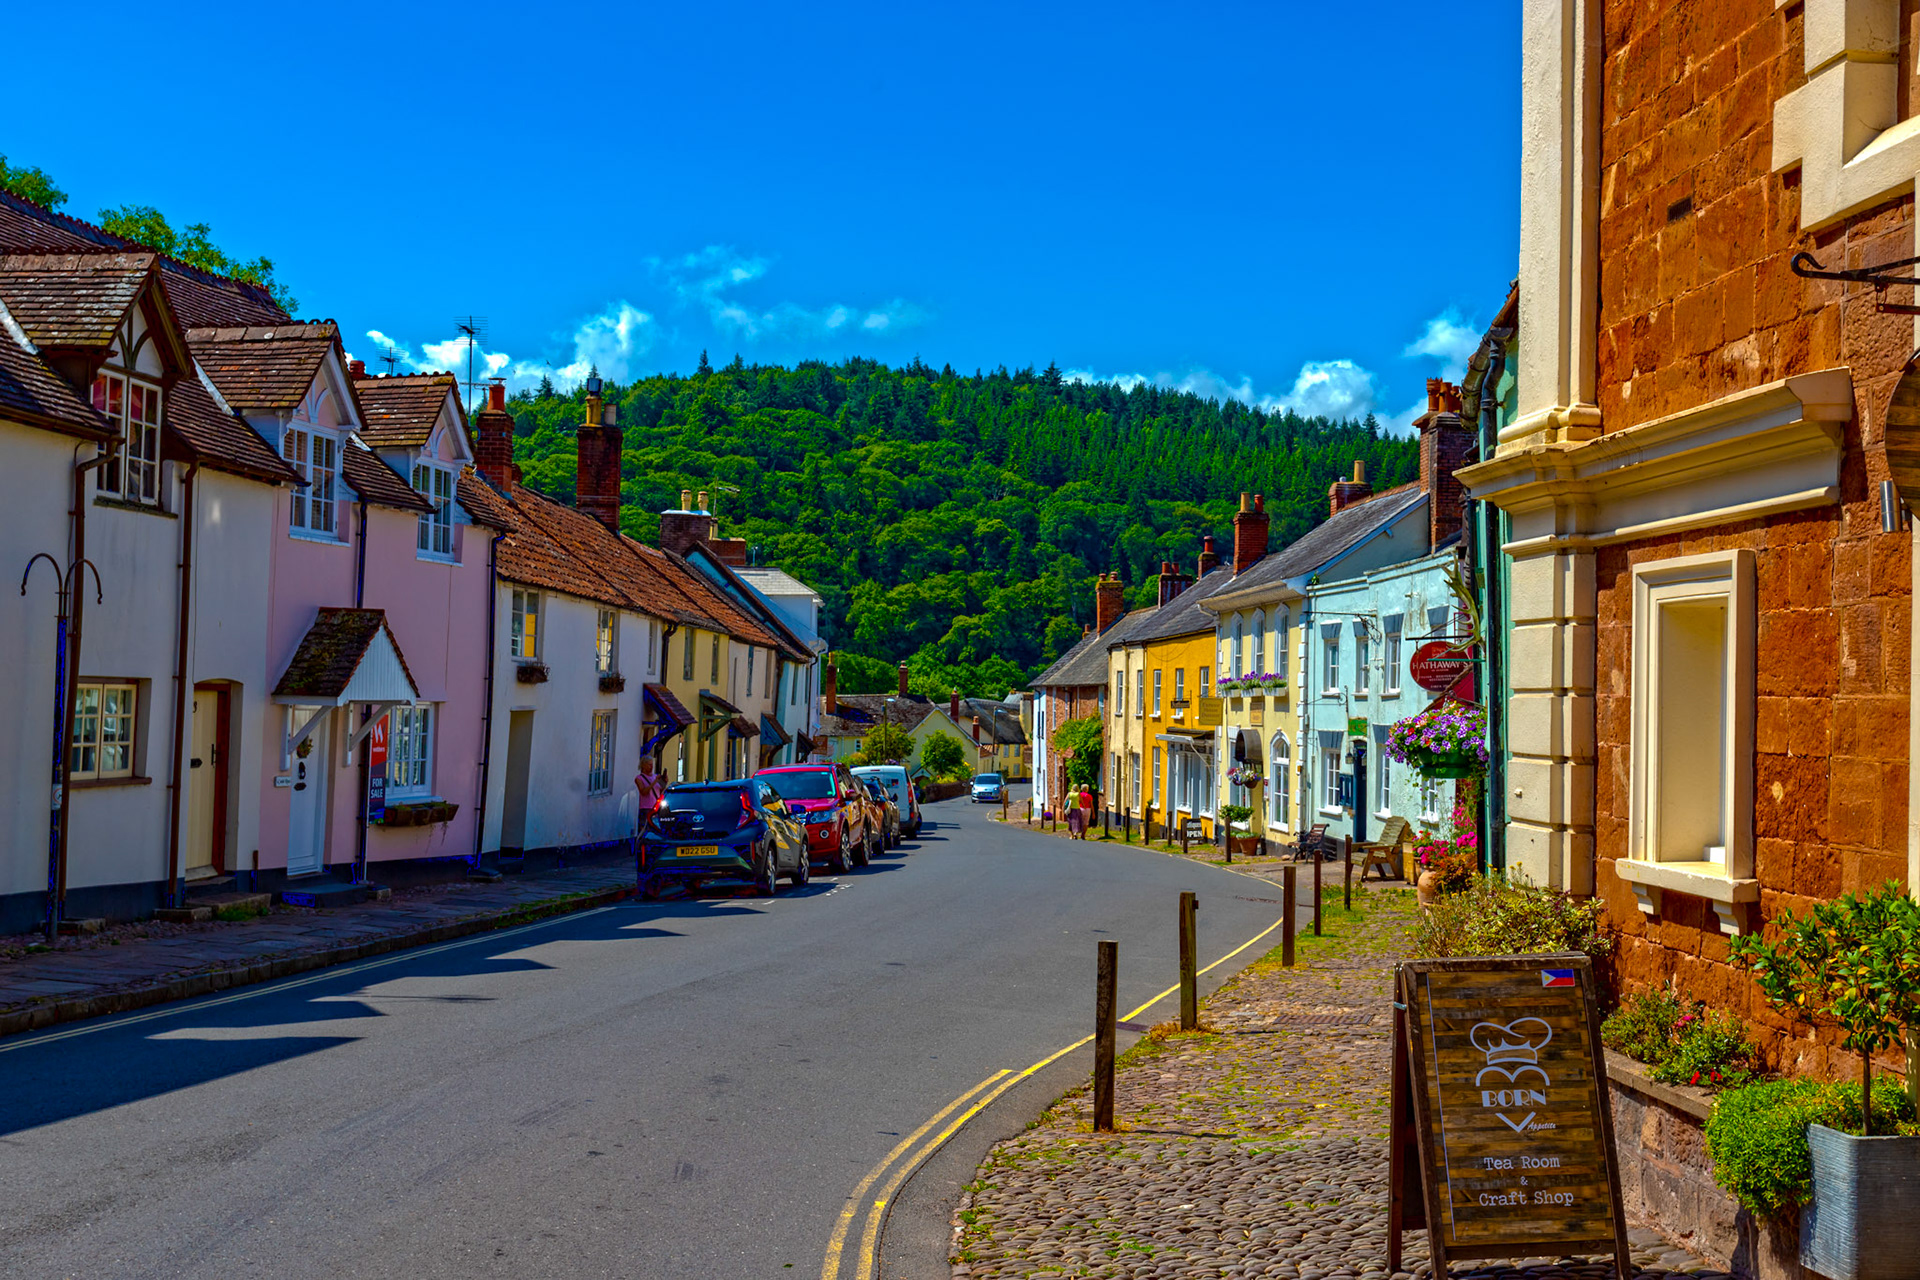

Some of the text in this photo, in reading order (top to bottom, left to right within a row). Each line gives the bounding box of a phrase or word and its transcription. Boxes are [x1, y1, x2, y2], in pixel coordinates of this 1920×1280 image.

[1412, 661, 1468, 670] HATHAWAY'S
[372, 777, 383, 787] FOR
[370, 788, 383, 799] SALE
[1481, 1088, 1547, 1107] BORN
[1527, 1121, 1556, 1131] Appetite
[1483, 1155, 1561, 1171] Tea Room
[1520, 1175, 1528, 1186] &
[1479, 1189, 1574, 1206] Craft Shop
